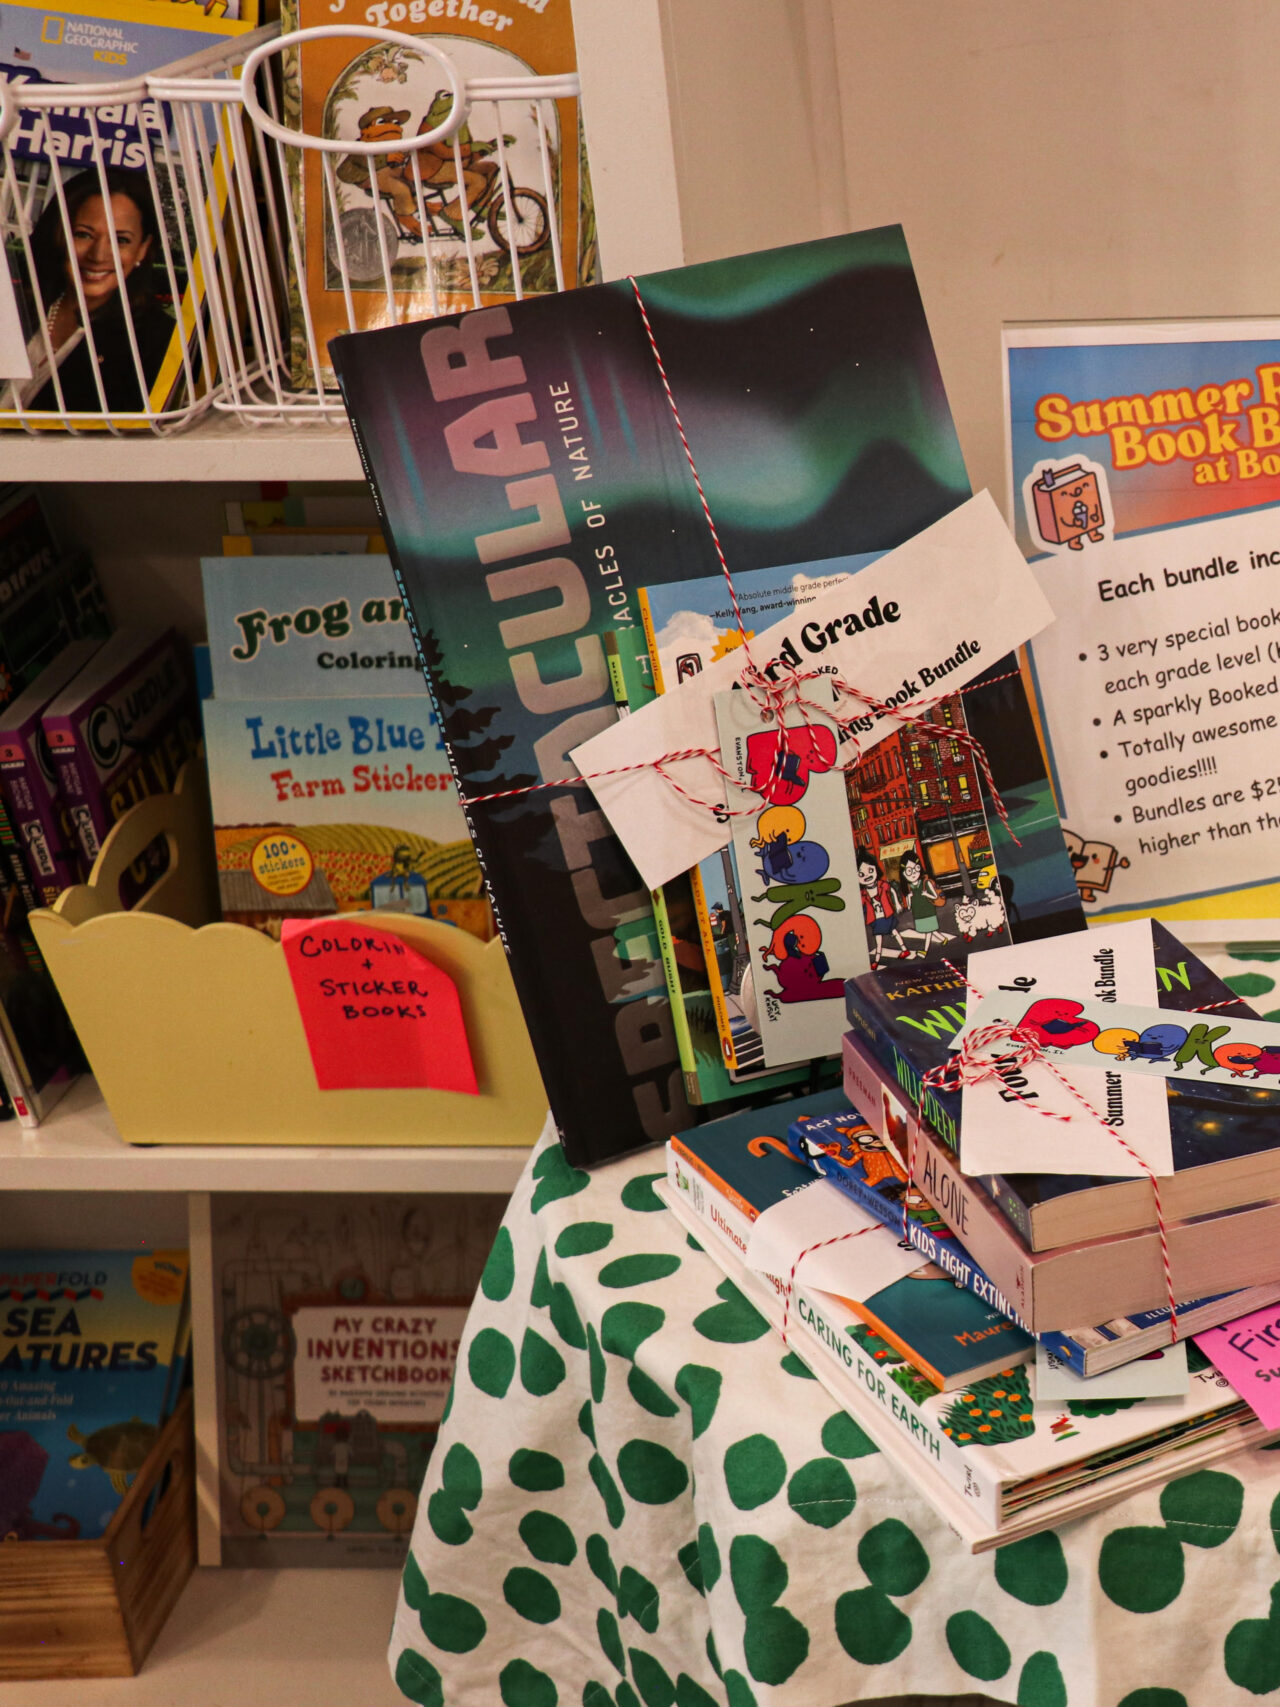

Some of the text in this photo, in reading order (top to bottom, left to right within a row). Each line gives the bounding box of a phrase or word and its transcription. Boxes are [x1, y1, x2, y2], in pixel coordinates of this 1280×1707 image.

[66, 21, 124, 38] NATIONAL
[365, 0, 513, 31] Together
[64, 33, 139, 54] GEOGRAPHIC
[9, 114, 146, 168] Harris
[1038, 380, 1252, 439] Summer
[1112, 413, 1238, 469] Book
[1194, 456, 1230, 486] at
[549, 380, 638, 634] ACLES OF NATURE
[772, 585, 798, 597] middle
[798, 580, 822, 595] grade
[1098, 574, 1155, 603] Each
[1163, 554, 1240, 590] bundle
[232, 598, 350, 660] Frog
[800, 595, 902, 654] Grade
[1097, 643, 1111, 663] 3
[1115, 636, 1159, 662] very
[1165, 617, 1231, 652] special
[917, 638, 982, 688] Bundle
[1104, 671, 1150, 696] each
[1155, 657, 1212, 689] grade
[1215, 644, 1262, 672] level
[1112, 708, 1127, 728] A
[1132, 692, 1202, 726] sparkly
[1208, 678, 1279, 708] Booked
[245, 716, 342, 760] Little
[347, 714, 425, 755] Blue
[1117, 728, 1186, 761] Totally
[1191, 714, 1278, 745] awesome
[270, 768, 346, 801] Farm
[1125, 756, 1218, 797] goodies!!!!
[1131, 797, 1207, 825] Bundles
[1212, 788, 1246, 806] are
[263, 840, 297, 859] 100+
[1138, 830, 1202, 857] higher
[1206, 819, 1252, 843] than
[258, 855, 307, 875] stickers
[475, 847, 487, 872] OF
[484, 878, 512, 957] NATURE
[320, 978, 429, 998] STICKER
[1093, 947, 1116, 988] Bundle
[342, 1004, 427, 1020] BOOKS
[1104, 1070, 1124, 1127] Summer
[923, 1150, 970, 1236] ALONE
[710, 1204, 748, 1255] Ultimate
[909, 1223, 937, 1260] KIDS
[939, 1247, 972, 1286] FIGHT
[2, 1306, 82, 1337] SEA
[333, 1316, 438, 1334] MY CRAZY
[307, 1338, 462, 1361] INVENTIONS
[320, 1365, 453, 1384] SKETCHBOOK
[798, 1299, 941, 1461] CARING FOR EARTH
